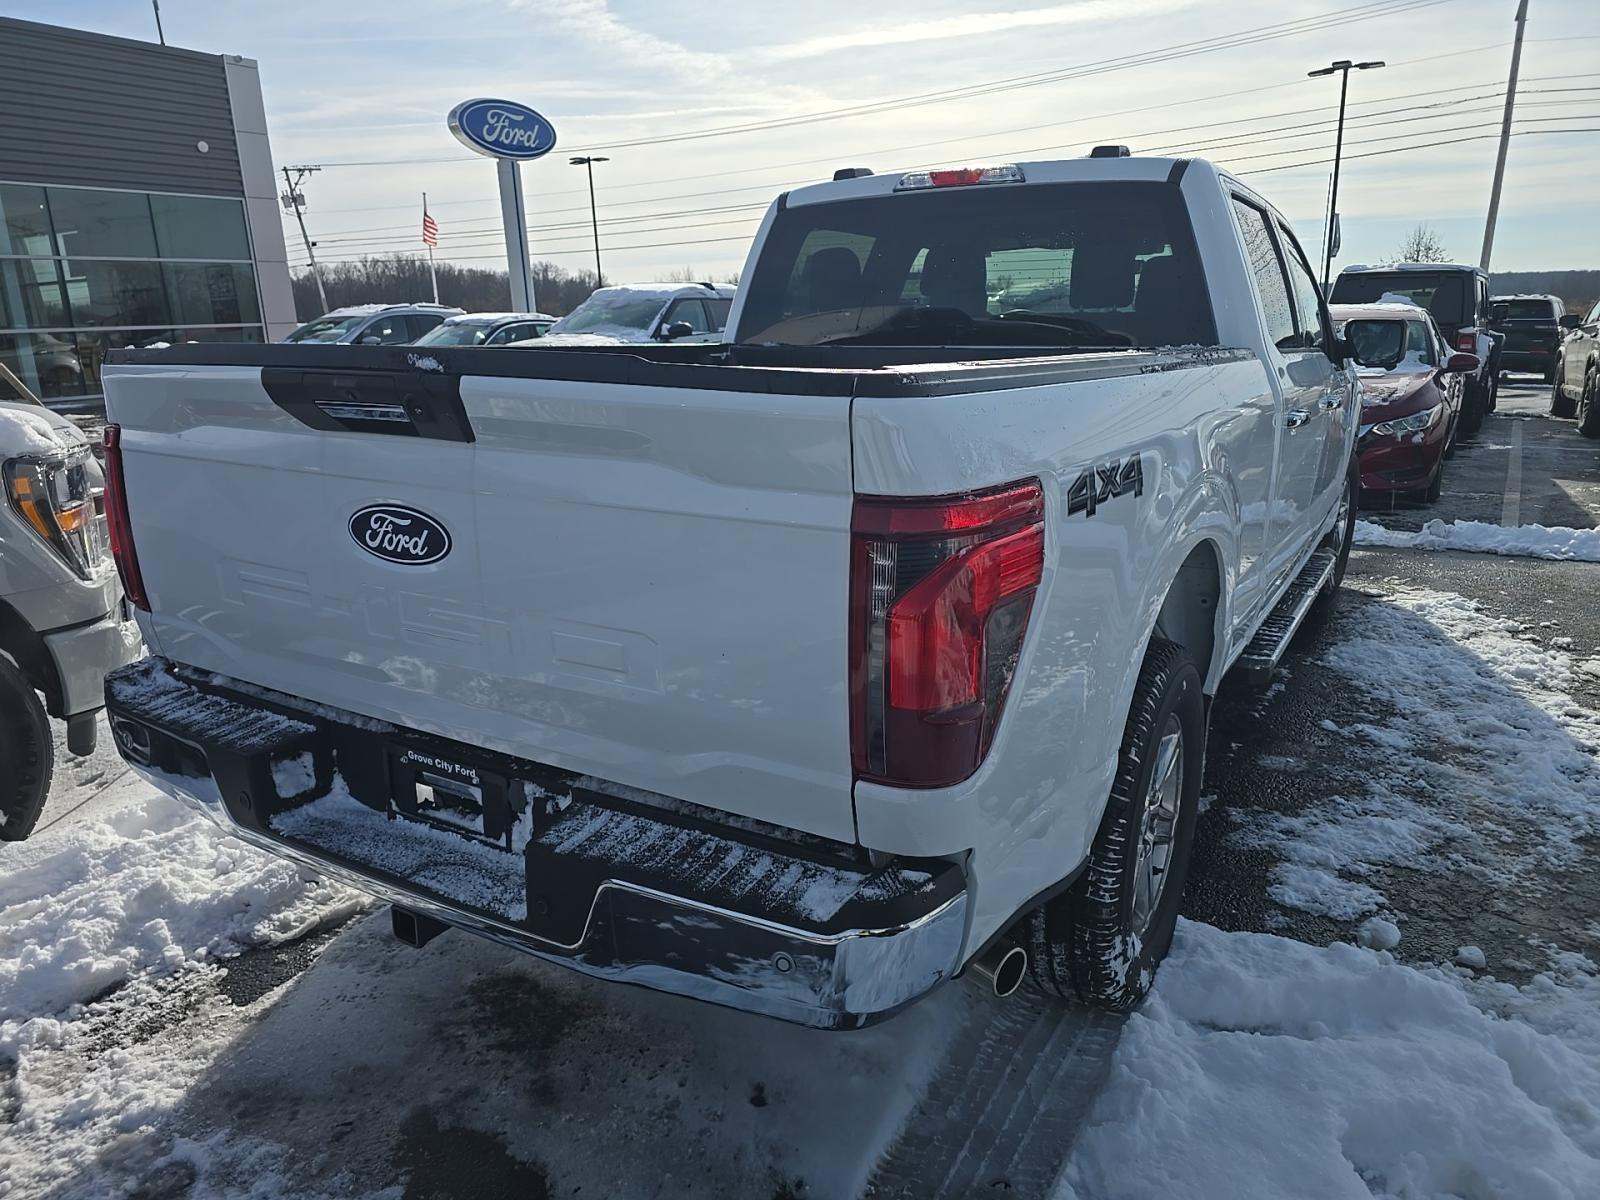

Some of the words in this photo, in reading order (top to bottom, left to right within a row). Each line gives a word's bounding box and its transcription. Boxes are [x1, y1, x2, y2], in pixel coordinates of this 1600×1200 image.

[482, 109, 539, 148] Ford
[365, 512, 428, 556] Ford
[408, 750, 433, 766] Grove
[434, 758, 455, 773] City
[455, 763, 477, 778] Ford
